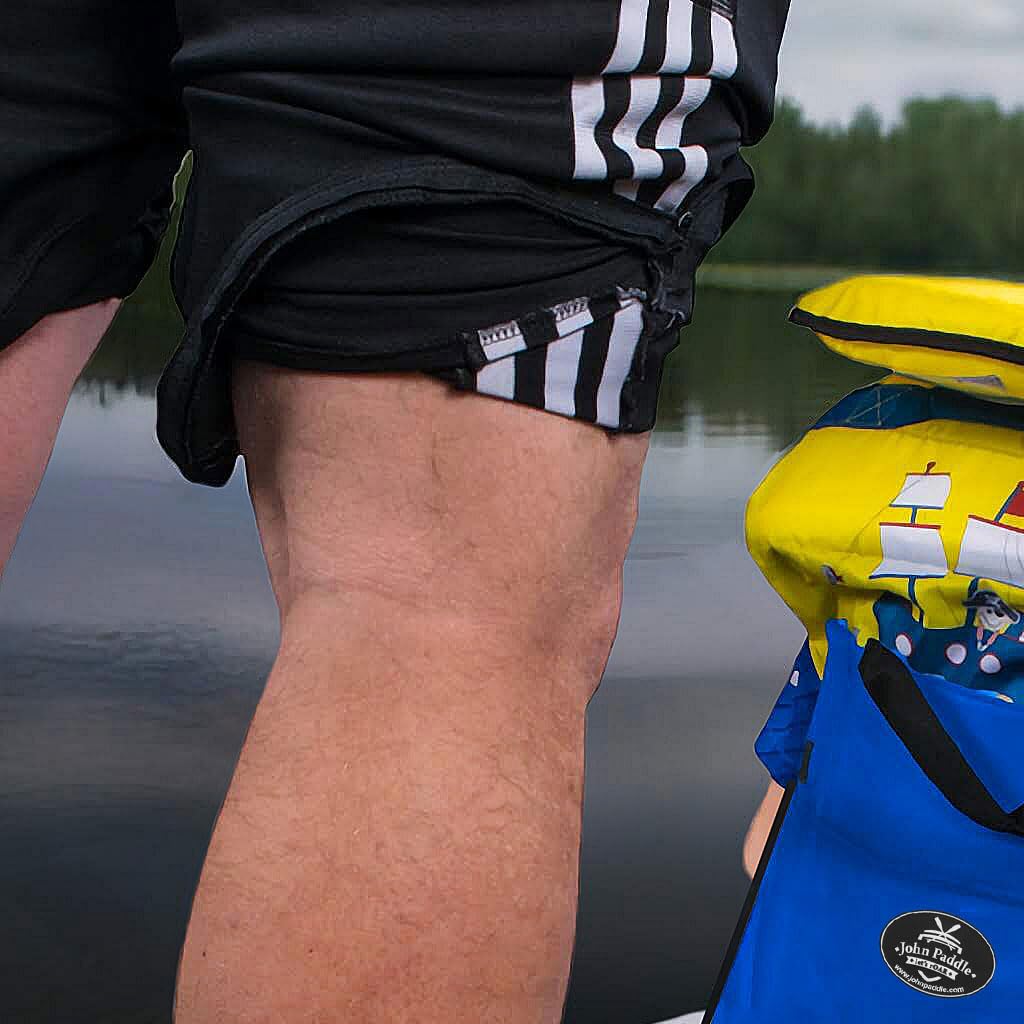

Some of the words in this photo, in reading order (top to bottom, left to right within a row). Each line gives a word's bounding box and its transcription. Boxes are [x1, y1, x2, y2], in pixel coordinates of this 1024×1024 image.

[899, 941, 930, 957] John
[933, 947, 972, 976] Paddle
[894, 964, 964, 993] www.johnpaddle.com
